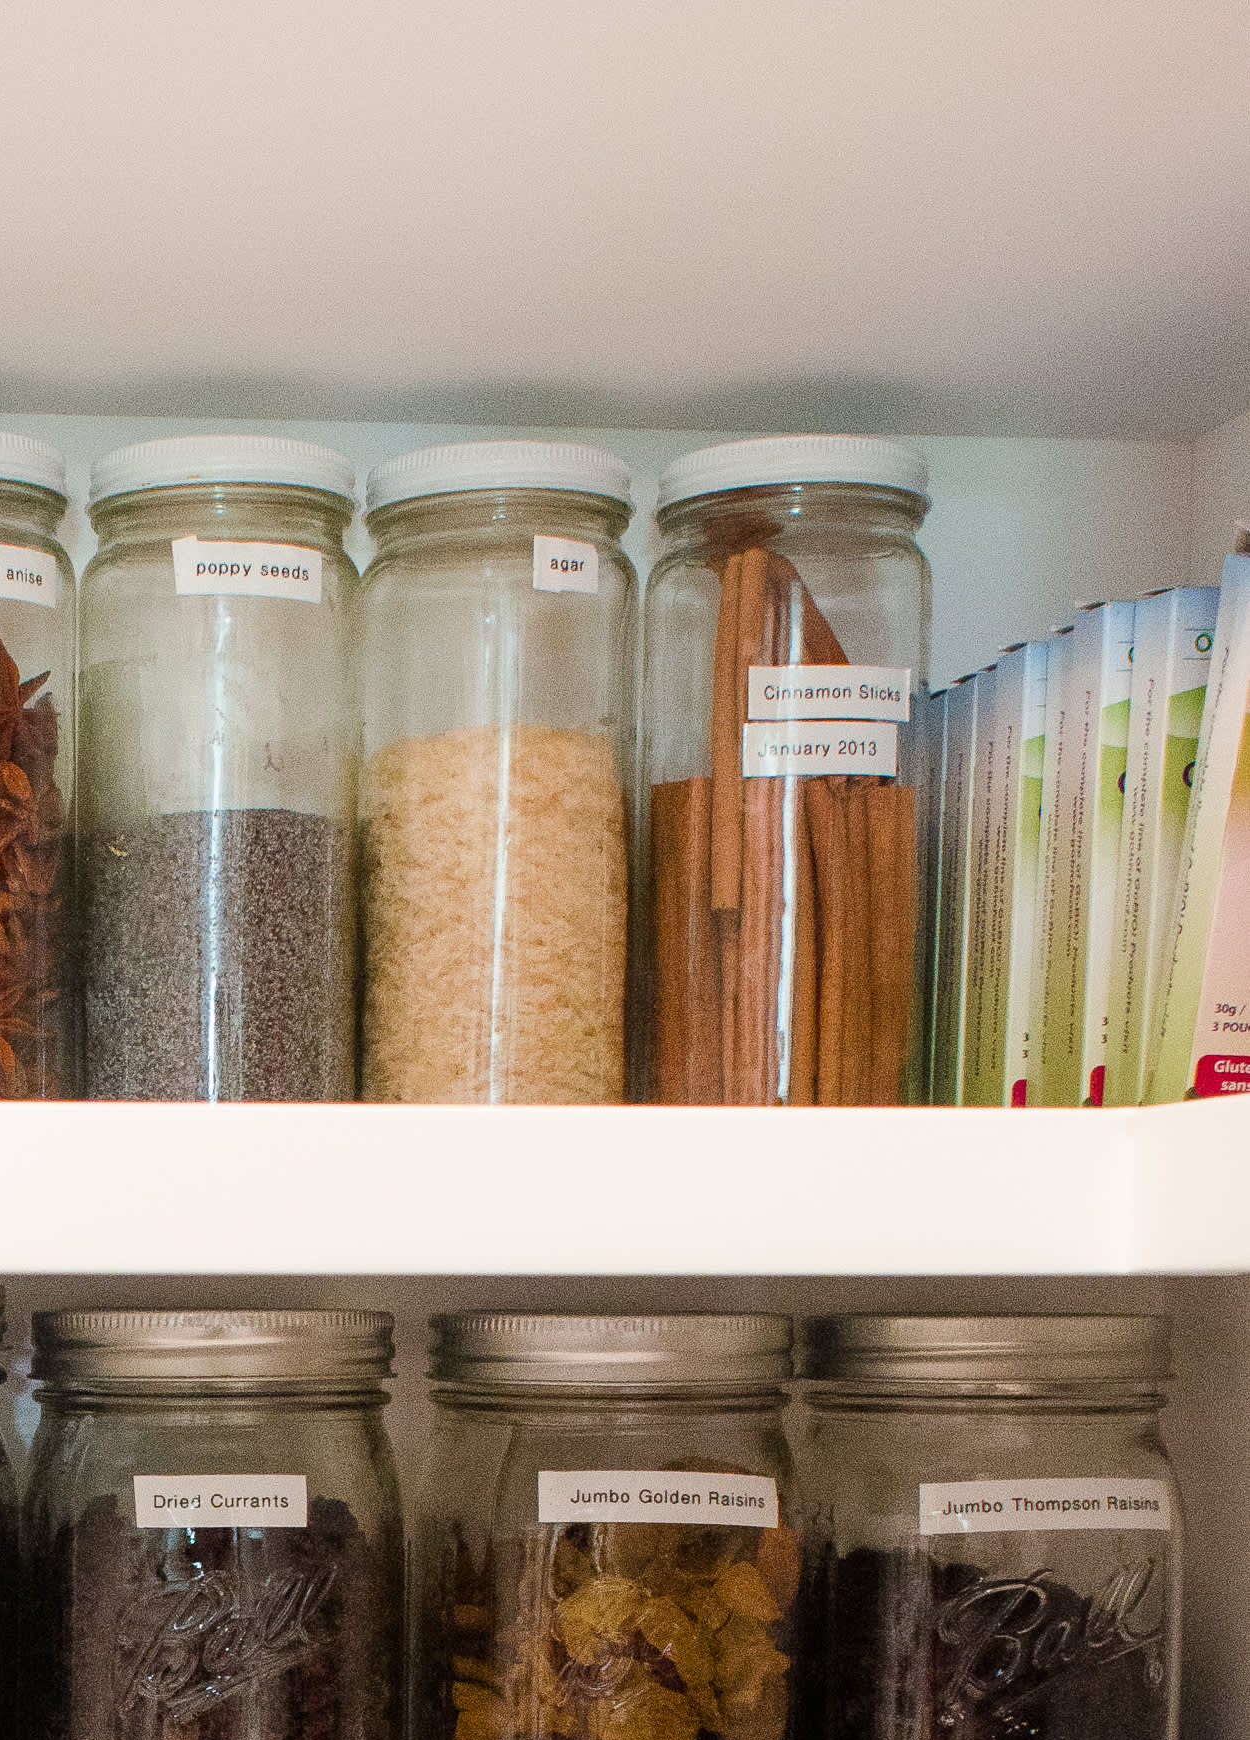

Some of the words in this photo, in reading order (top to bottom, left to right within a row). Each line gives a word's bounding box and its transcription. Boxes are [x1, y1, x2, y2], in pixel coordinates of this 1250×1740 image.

[196, 562, 252, 578] poppy
[260, 564, 310, 582] seeds
[550, 557, 585, 573] agar
[6, 568, 43, 587] anise
[763, 684, 852, 701] Cinnamon
[858, 684, 901, 703] Sticks
[757, 740, 831, 758] January
[837, 739, 878, 757] 2013
[1214, 1003, 1237, 1016] 30g
[1211, 1021, 1218, 1031] 3
[153, 1493, 202, 1509] Dried
[210, 1493, 289, 1509] Currants
[570, 1488, 631, 1504] Jumbo
[638, 1488, 701, 1505] Golden
[708, 1490, 766, 1509] Raisins
[942, 1498, 1004, 1516] Jumbo
[1011, 1496, 1101, 1513] Thompson
[1106, 1494, 1160, 1512] Raisins
